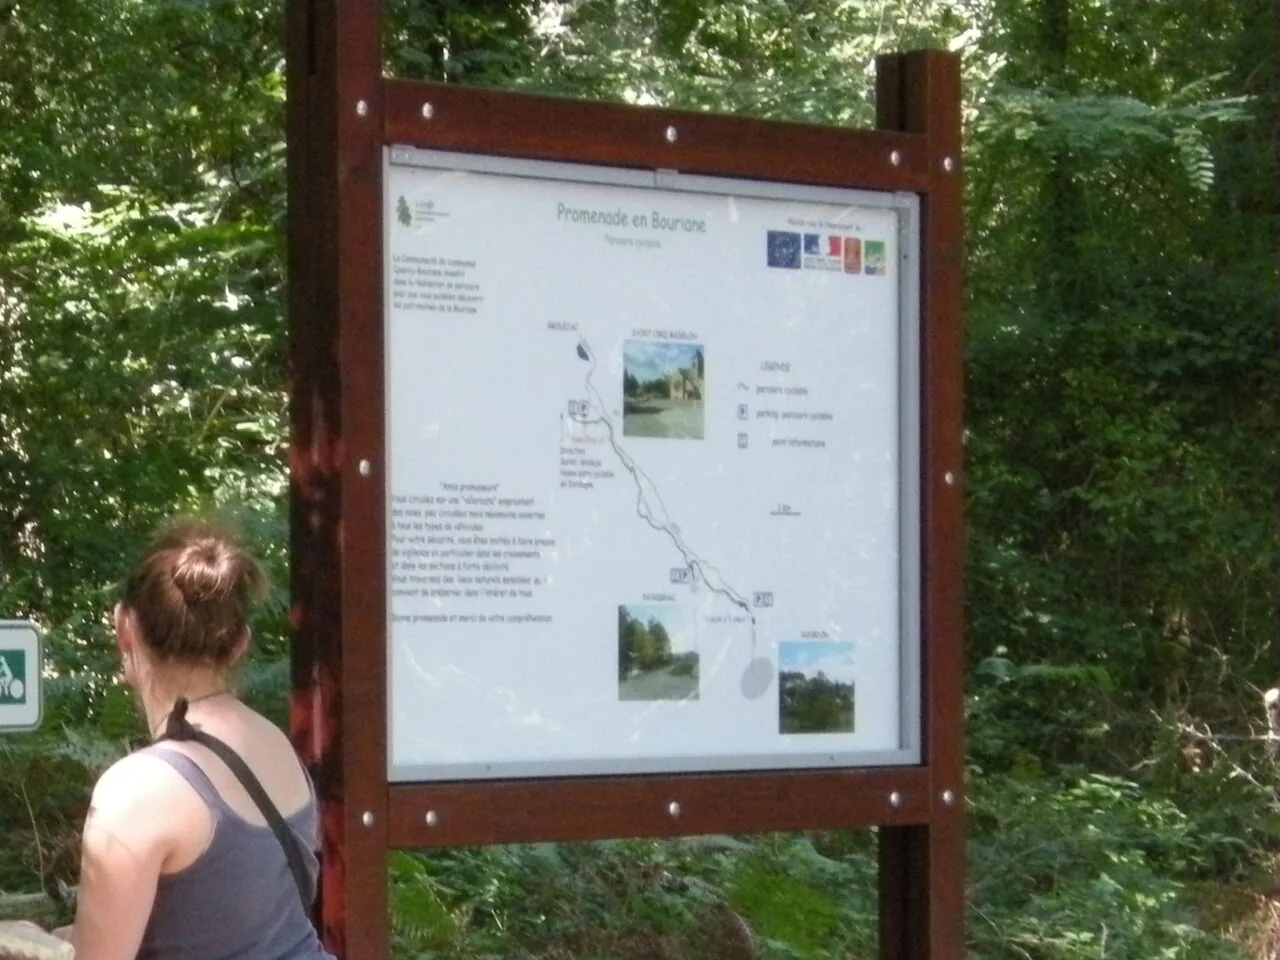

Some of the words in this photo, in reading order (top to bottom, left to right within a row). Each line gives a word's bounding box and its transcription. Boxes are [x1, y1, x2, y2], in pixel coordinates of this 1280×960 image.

[557, 203, 628, 227] Promenade
[632, 216, 647, 229] en
[651, 211, 706, 233] Bouriane
